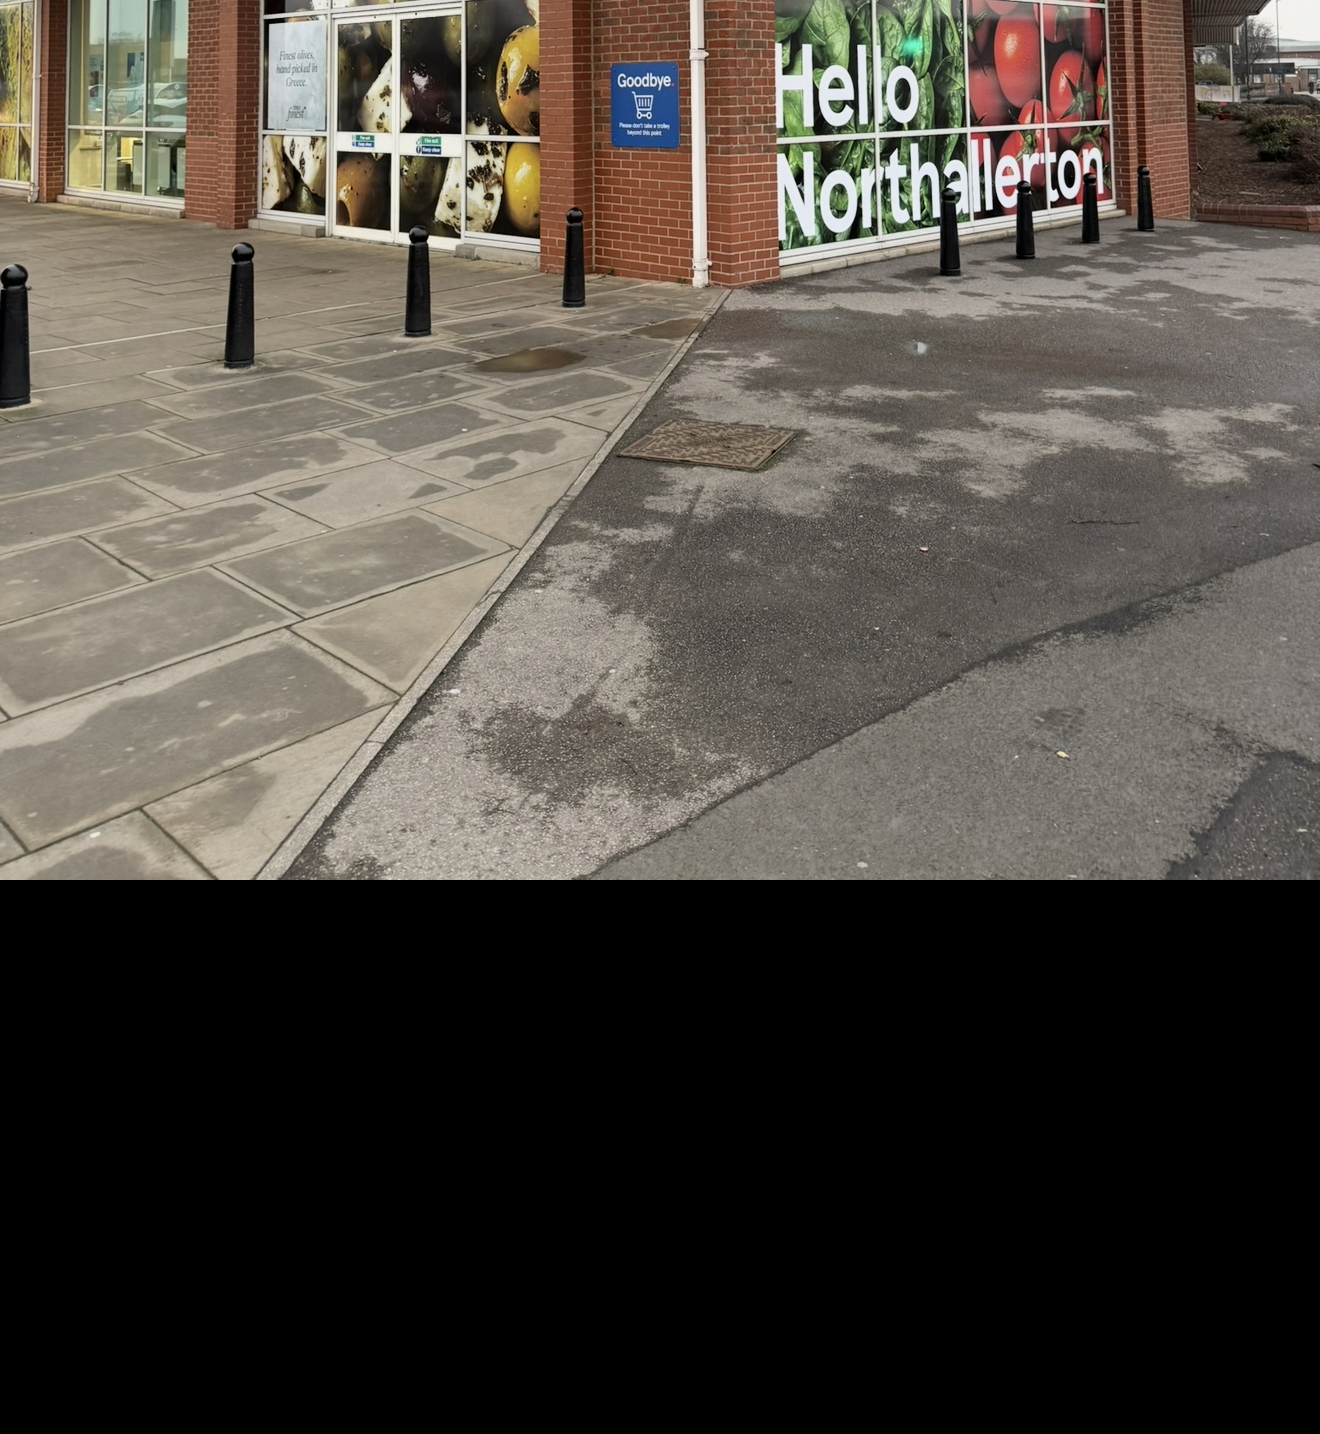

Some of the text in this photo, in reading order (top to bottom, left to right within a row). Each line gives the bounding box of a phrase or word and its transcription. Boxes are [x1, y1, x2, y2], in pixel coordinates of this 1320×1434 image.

[279, 49, 315, 61] Finest olives,
[311, 63, 318, 73] in
[286, 77, 307, 87] Greece.
[617, 72, 674, 91] Goodbye.
[776, 43, 919, 128] Hello
[657, 123, 670, 131] trolley
[627, 129, 642, 137] beyond
[777, 136, 1104, 241] Northallerton
